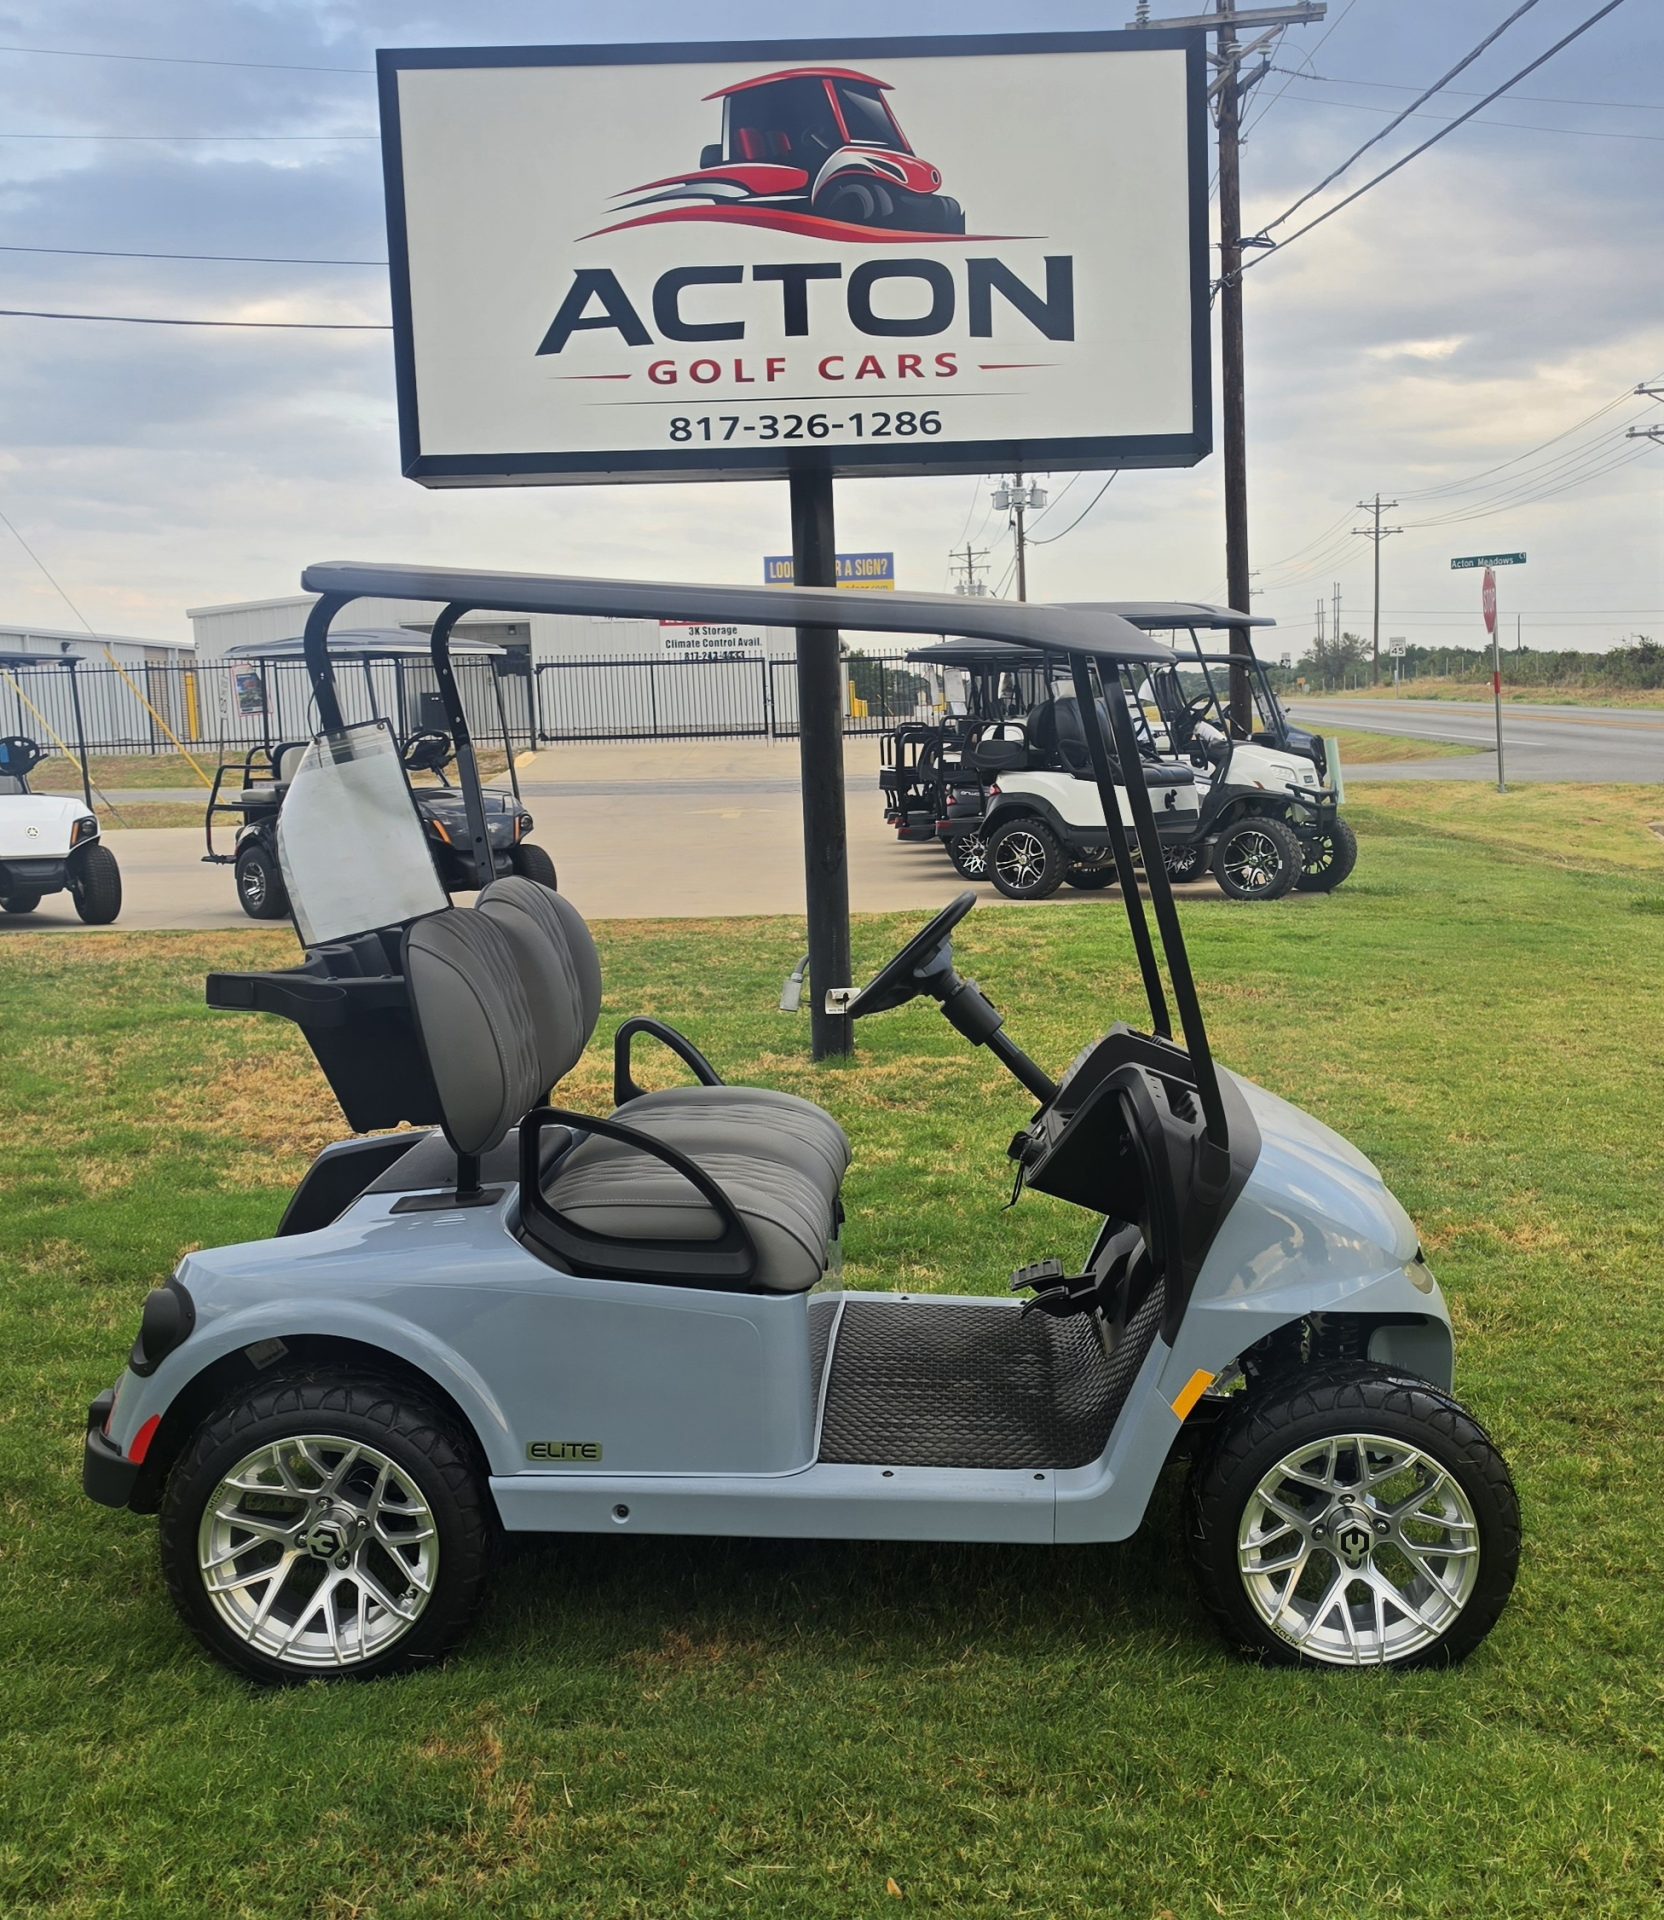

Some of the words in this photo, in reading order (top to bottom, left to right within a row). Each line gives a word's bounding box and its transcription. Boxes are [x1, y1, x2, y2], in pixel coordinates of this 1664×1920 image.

[535, 255, 1075, 356] ACTON
[648, 357, 786, 385] GOLF
[818, 352, 958, 381] CARS
[669, 411, 942, 442] 817-326-1286
[844, 560, 853, 576] A
[855, 558, 888, 576] SIGN?
[1451, 559, 1475, 568] Acton
[1477, 557, 1514, 566] Meadows
[689, 626, 701, 636] 3K
[702, 626, 738, 636] Storage
[665, 638, 701, 649] Climate
[702, 637, 736, 648] Control
[737, 637, 763, 647] Avail.
[1391, 647, 1405, 655] 45
